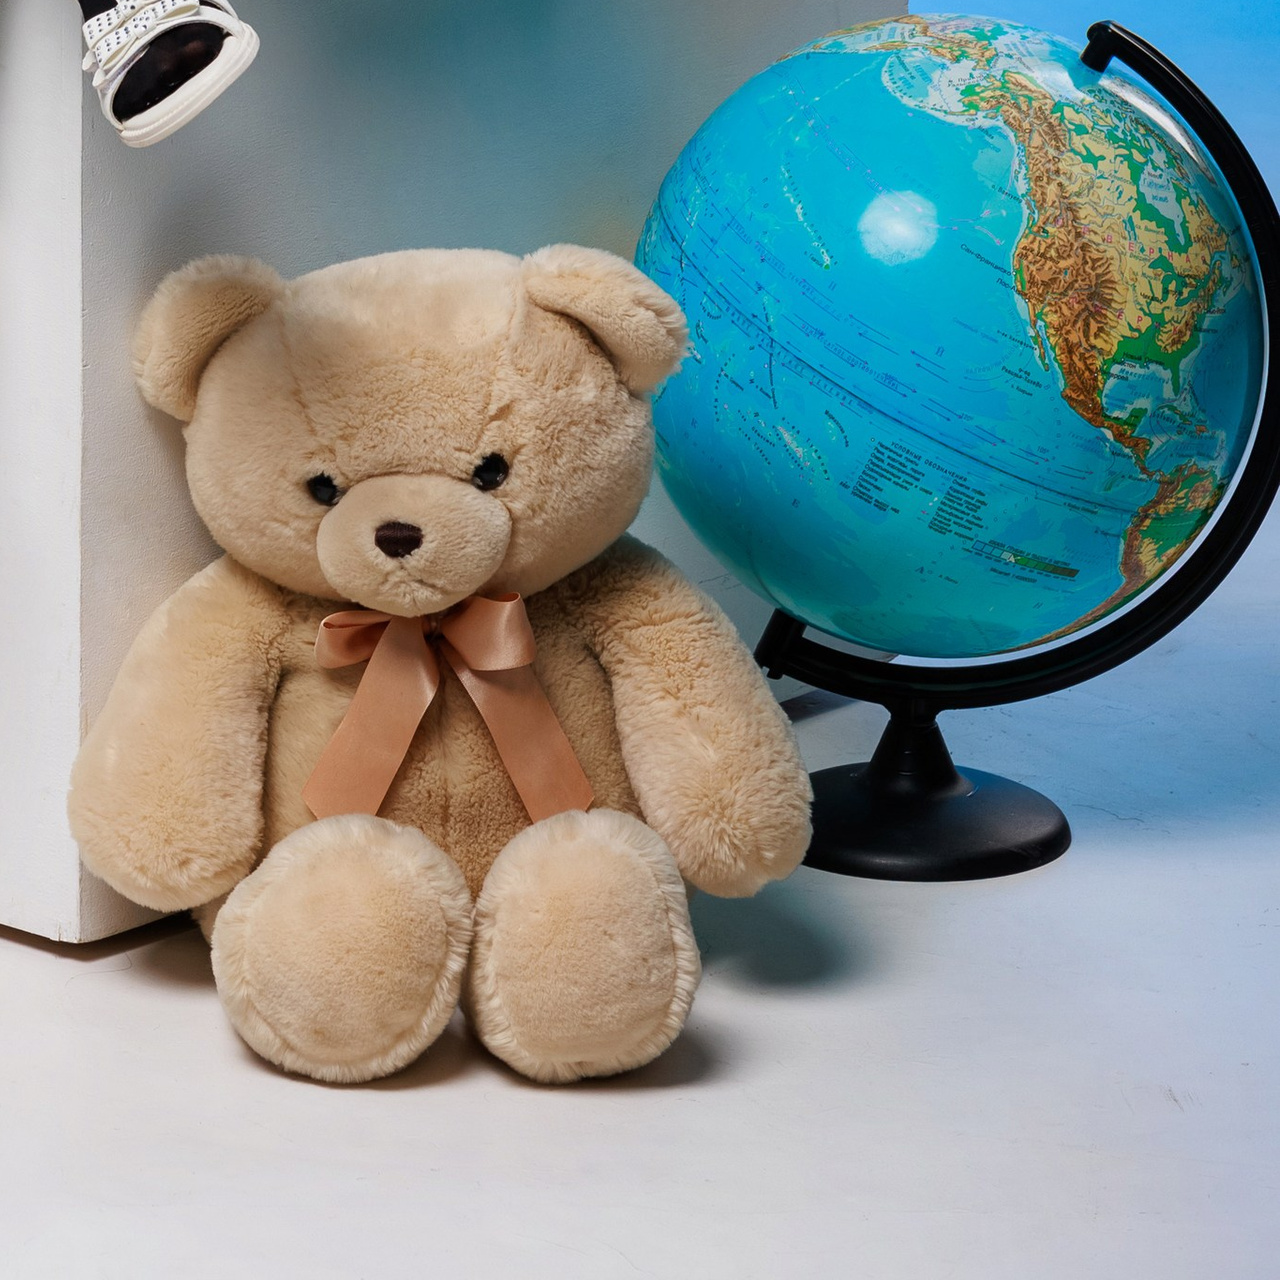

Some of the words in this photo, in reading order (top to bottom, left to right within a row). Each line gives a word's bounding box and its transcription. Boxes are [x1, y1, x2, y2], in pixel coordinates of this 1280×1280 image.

[960, 243, 1012, 277] Сан-Франциско
[891, 441, 922, 461] УСЛОВНЫЕ
[924, 459, 968, 482] ОБОЗНАЧЕНИЯ
